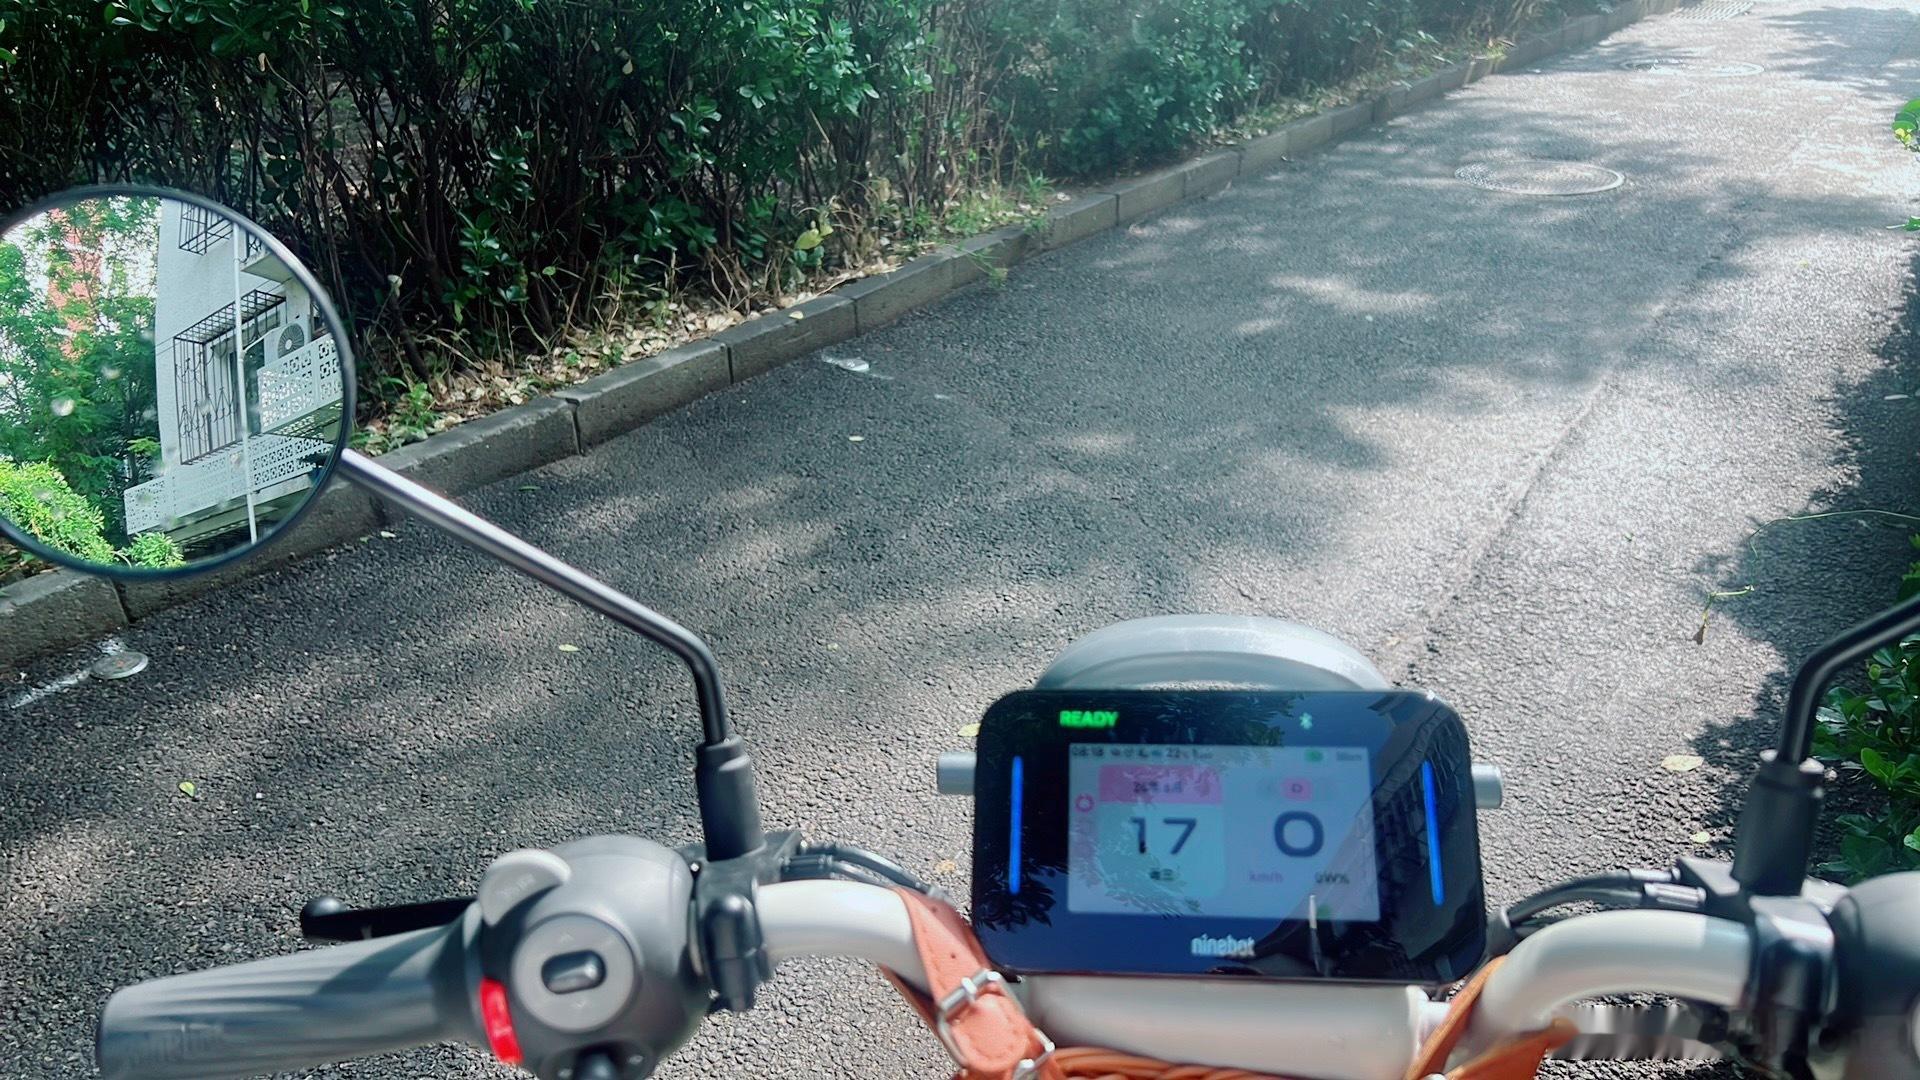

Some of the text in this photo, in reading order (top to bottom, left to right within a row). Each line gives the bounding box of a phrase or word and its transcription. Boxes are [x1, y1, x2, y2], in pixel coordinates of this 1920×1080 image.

[1059, 710, 1118, 727] READY
[1130, 816, 1198, 855] 17
[1273, 810, 1324, 858] 0
[1191, 933, 1256, 957] ninebot
